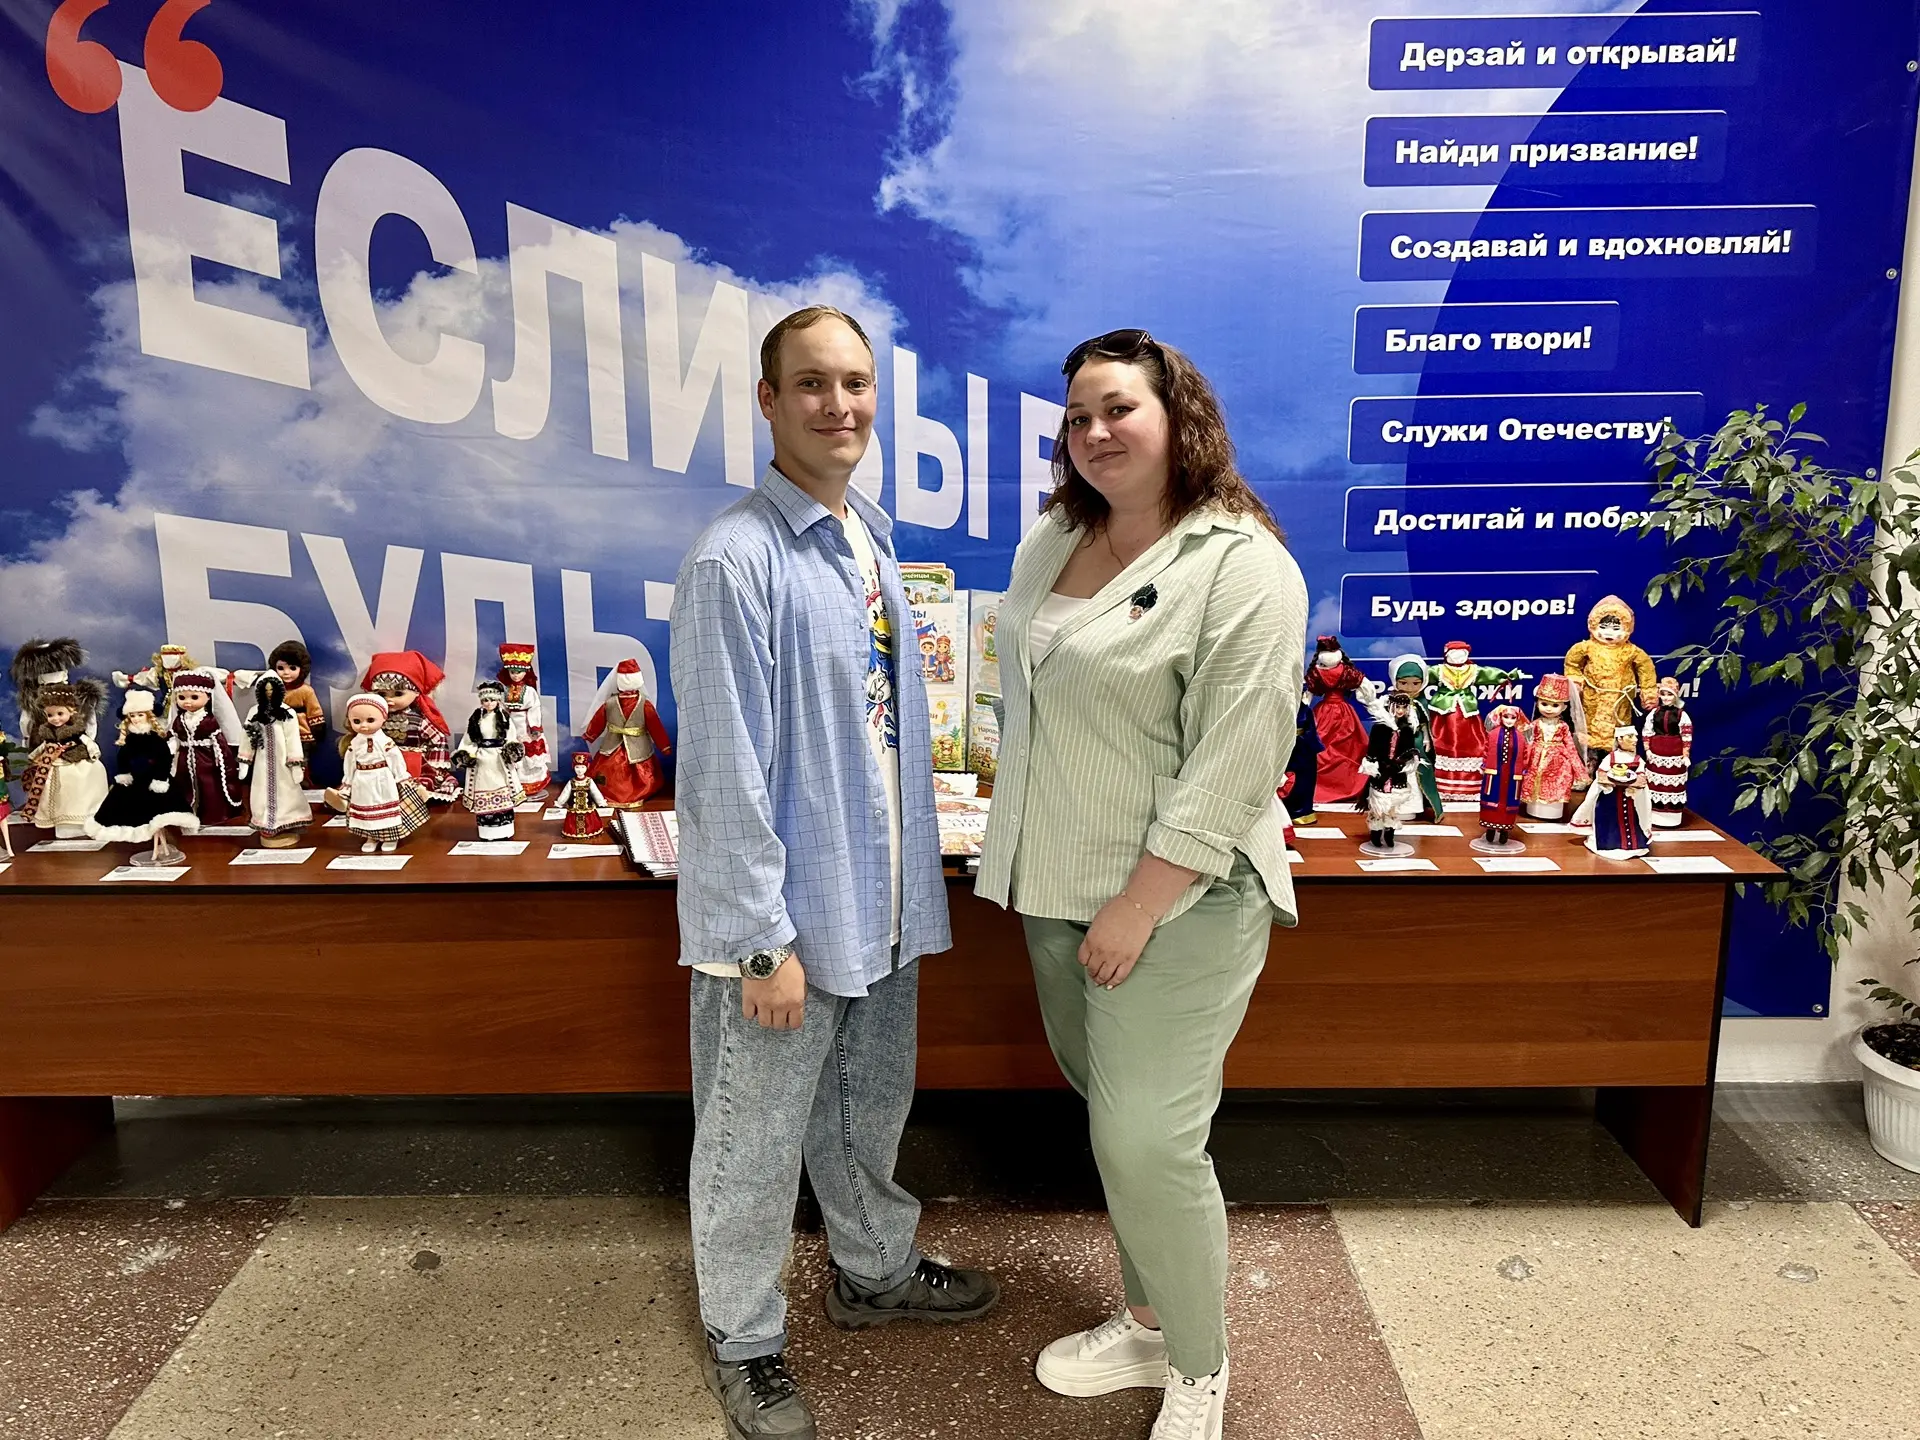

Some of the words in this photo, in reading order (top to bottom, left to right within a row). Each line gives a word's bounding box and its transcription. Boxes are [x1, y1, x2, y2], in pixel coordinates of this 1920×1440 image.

[1400, 41, 1526, 71] Дерзай
[1535, 44, 1556, 65] и
[1567, 38, 1738, 69] открывай!
[1395, 138, 1499, 167] Найди
[1509, 136, 1699, 168] призвание!
[1390, 232, 1548, 262] Создавай
[1558, 238, 1578, 257] и
[1589, 229, 1792, 260] вдохновляй!
[1385, 330, 1481, 353] Благо
[1491, 326, 1592, 354] твори!
[1381, 420, 1488, 448] Служи
[1499, 416, 1672, 446] Отечеству!
[1374, 507, 1525, 536] Достигай
[1535, 512, 1554, 529] и
[1371, 595, 1446, 621] Будь
[1455, 594, 1576, 619] здоров!
